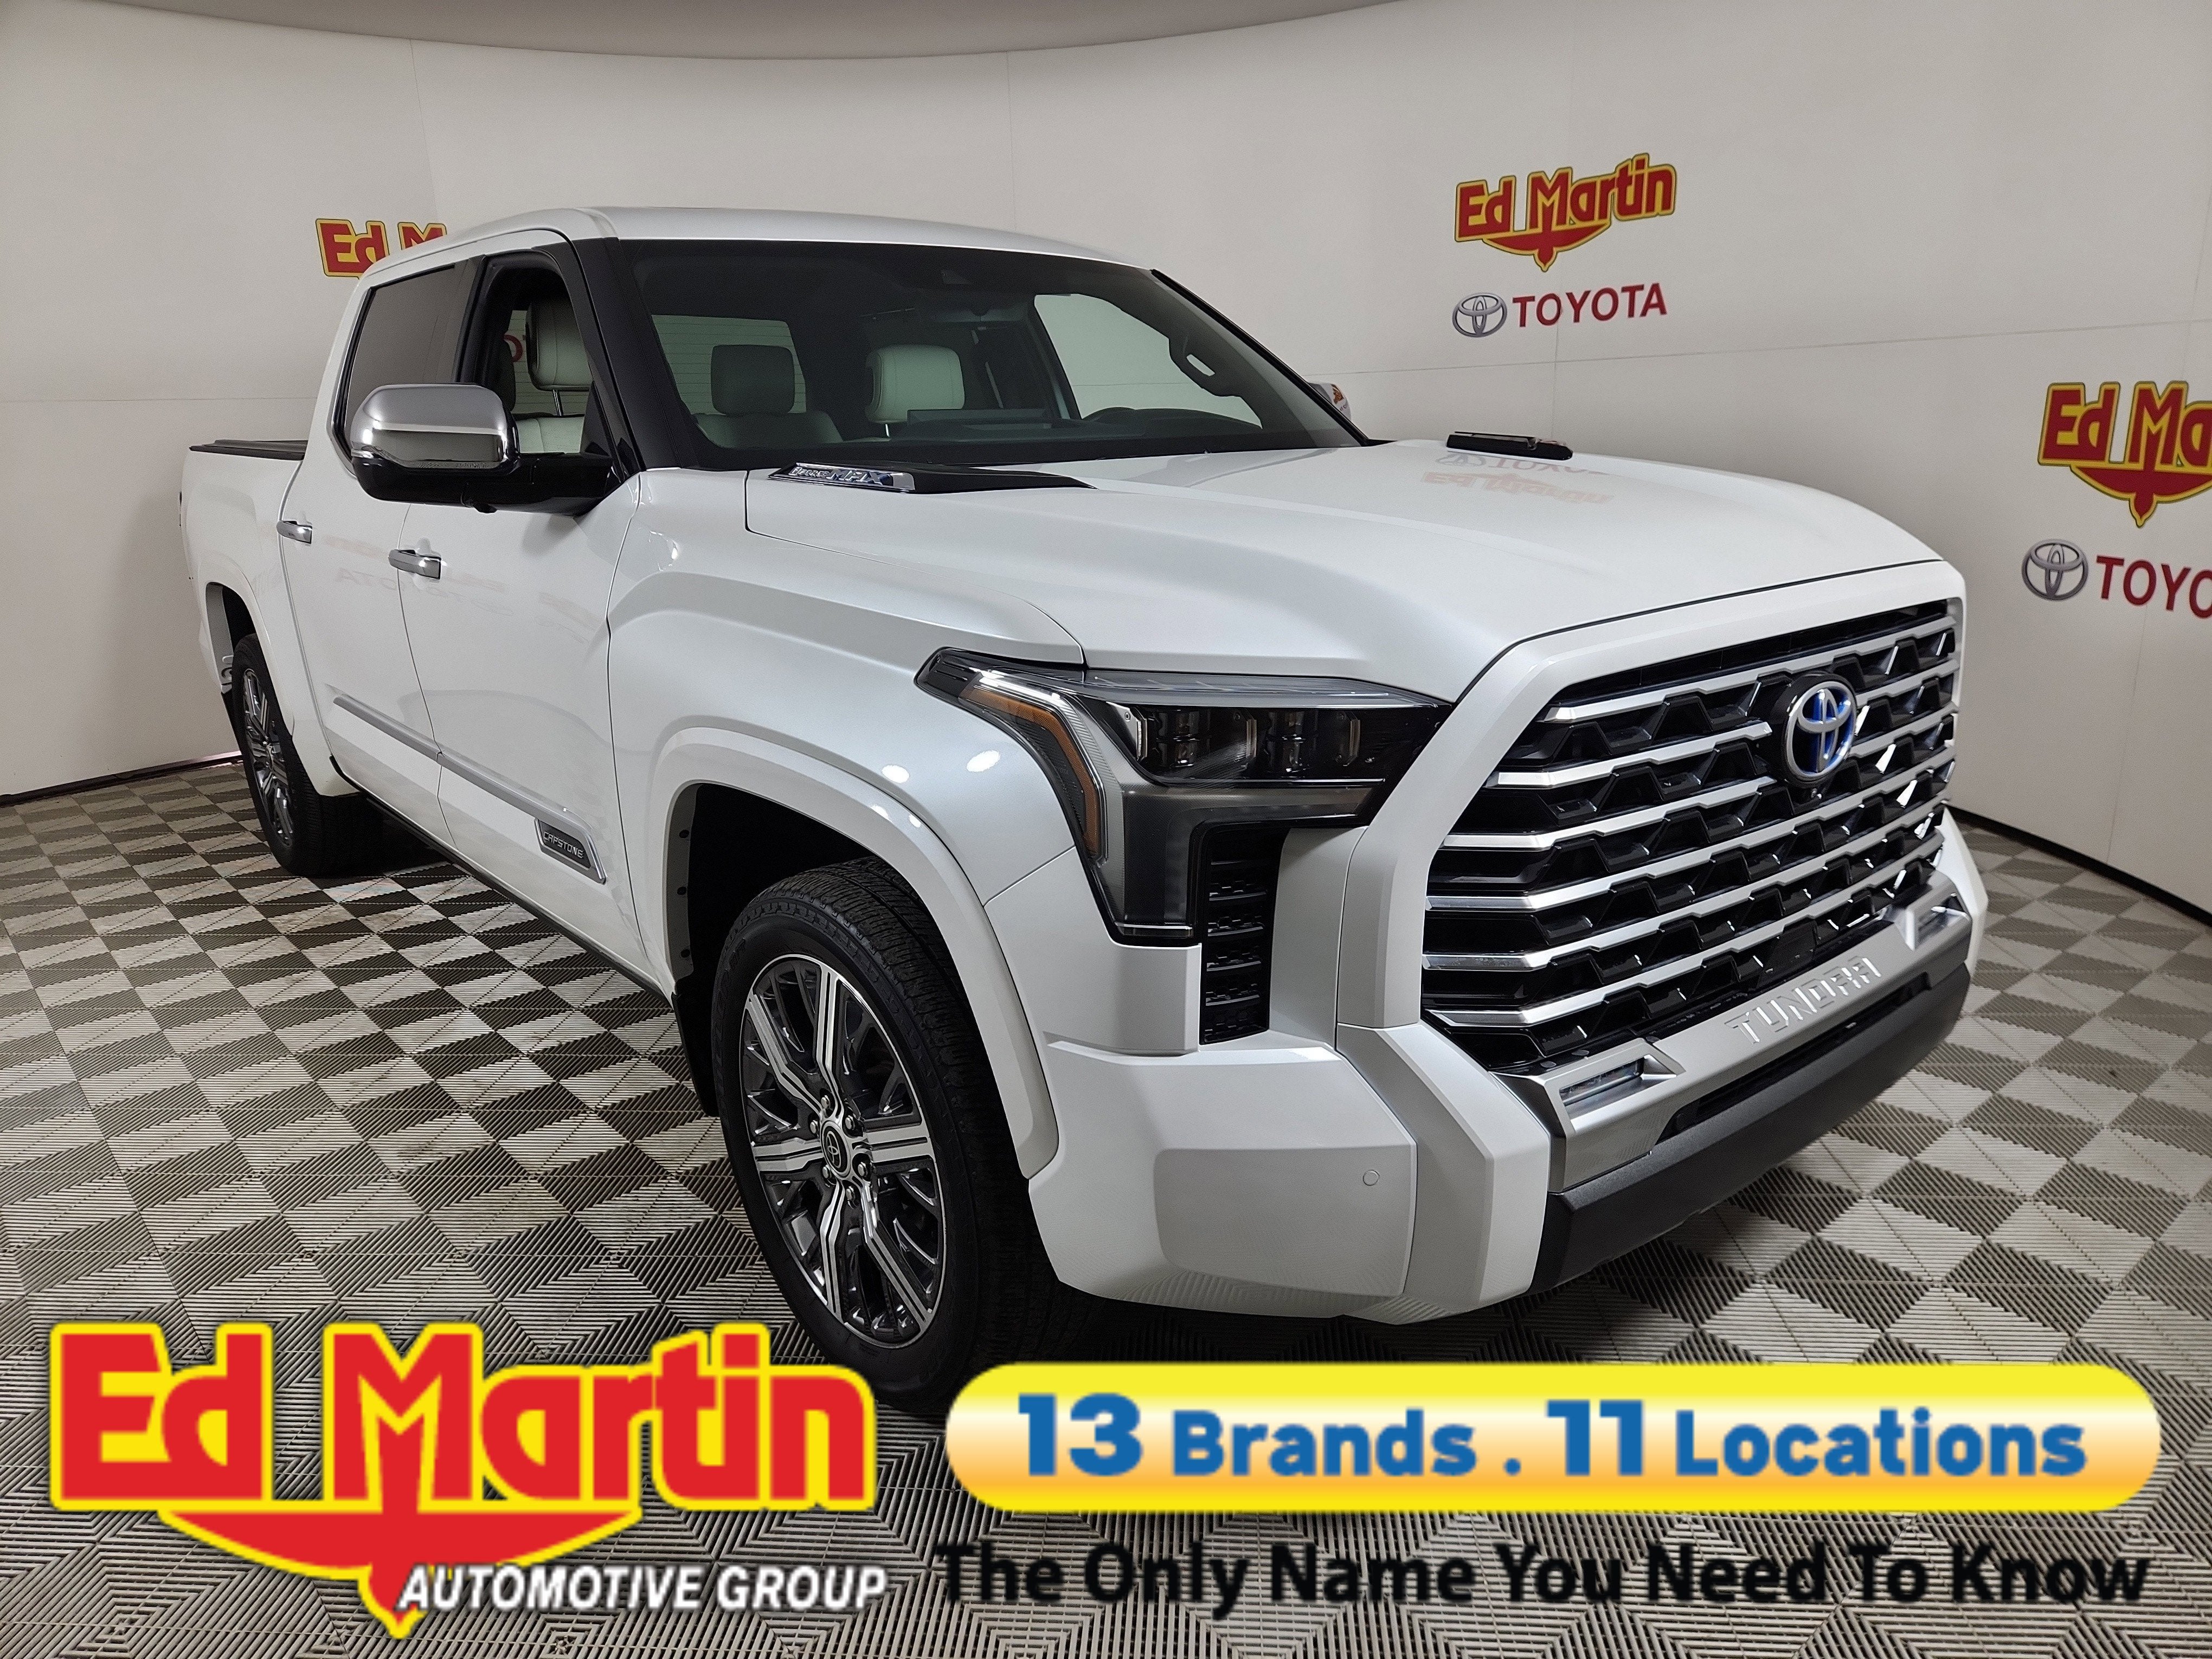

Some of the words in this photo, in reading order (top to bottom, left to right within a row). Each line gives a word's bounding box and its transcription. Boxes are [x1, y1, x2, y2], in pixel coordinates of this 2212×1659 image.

[1456, 177, 1515, 240] Ed
[1528, 155, 1675, 230] Martin
[317, 220, 388, 274] Ed
[1512, 282, 1667, 328] TOYOTA
[2040, 384, 2119, 464] Ed
[826, 469, 891, 486] MAX
[544, 831, 584, 859] CAPSTONE
[1724, 955, 1881, 1045] TUNDRA
